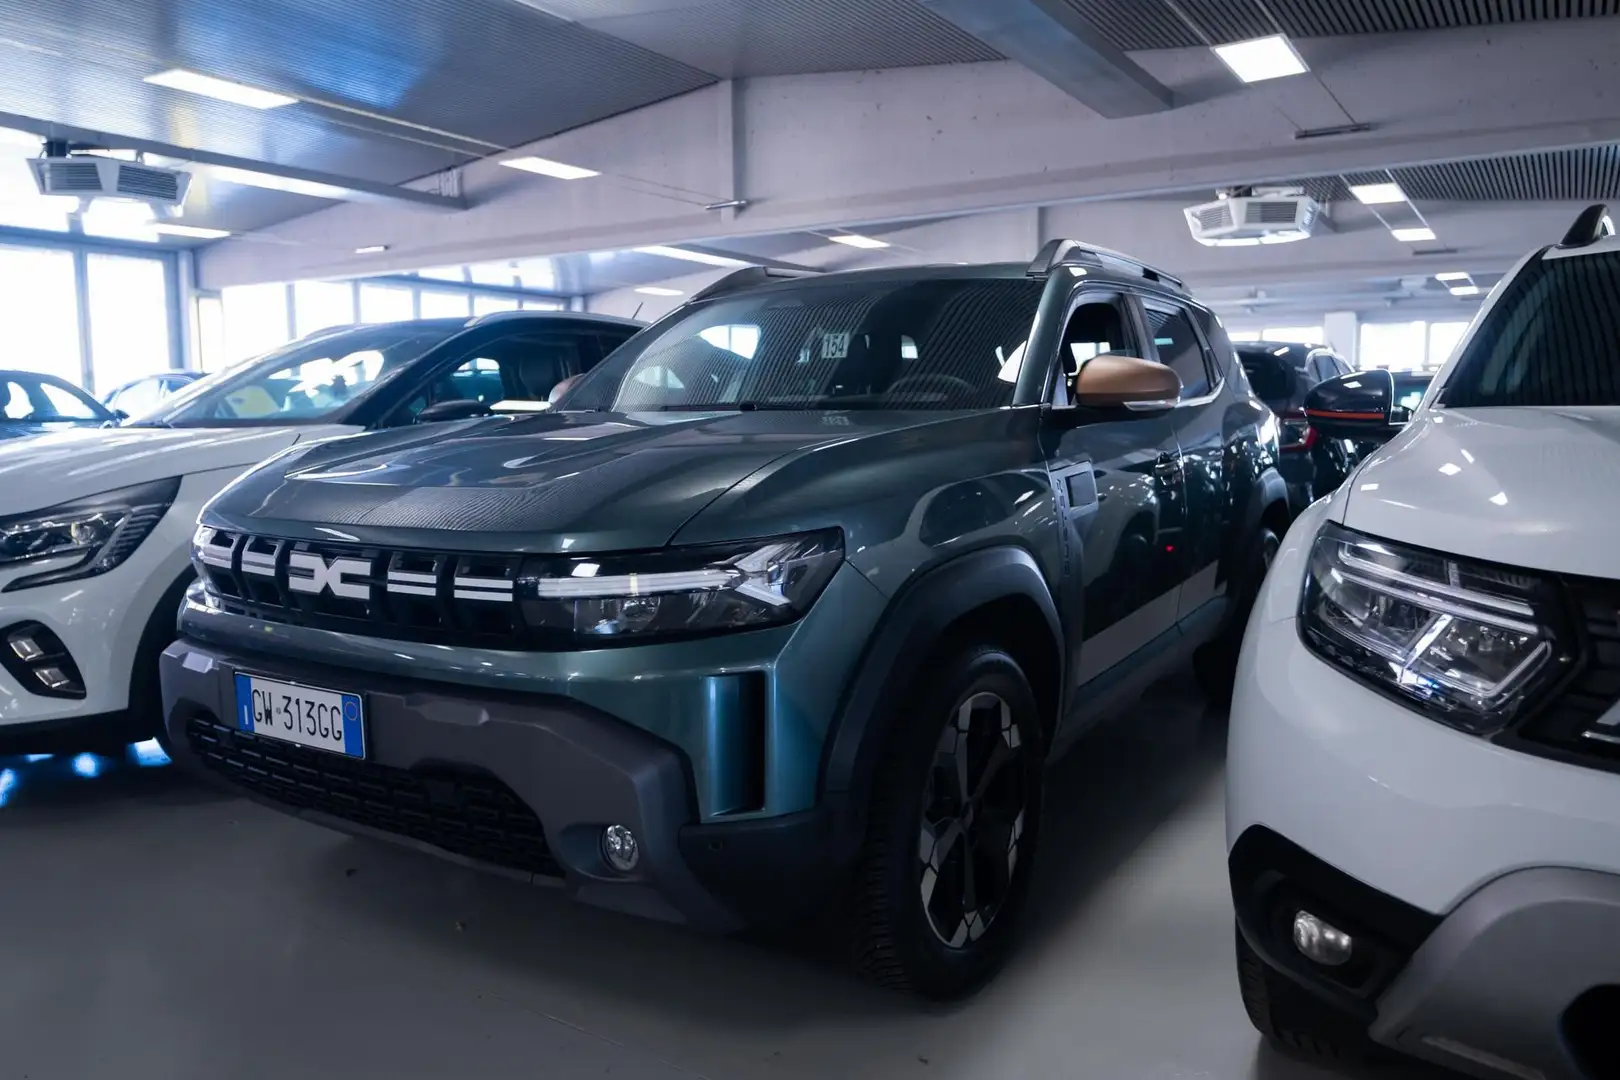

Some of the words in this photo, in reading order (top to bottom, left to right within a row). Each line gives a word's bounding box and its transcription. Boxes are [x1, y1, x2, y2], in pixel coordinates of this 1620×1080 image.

[824, 333, 845, 357] 154
[252, 688, 273, 726] GW
[281, 695, 343, 742] 313GG
